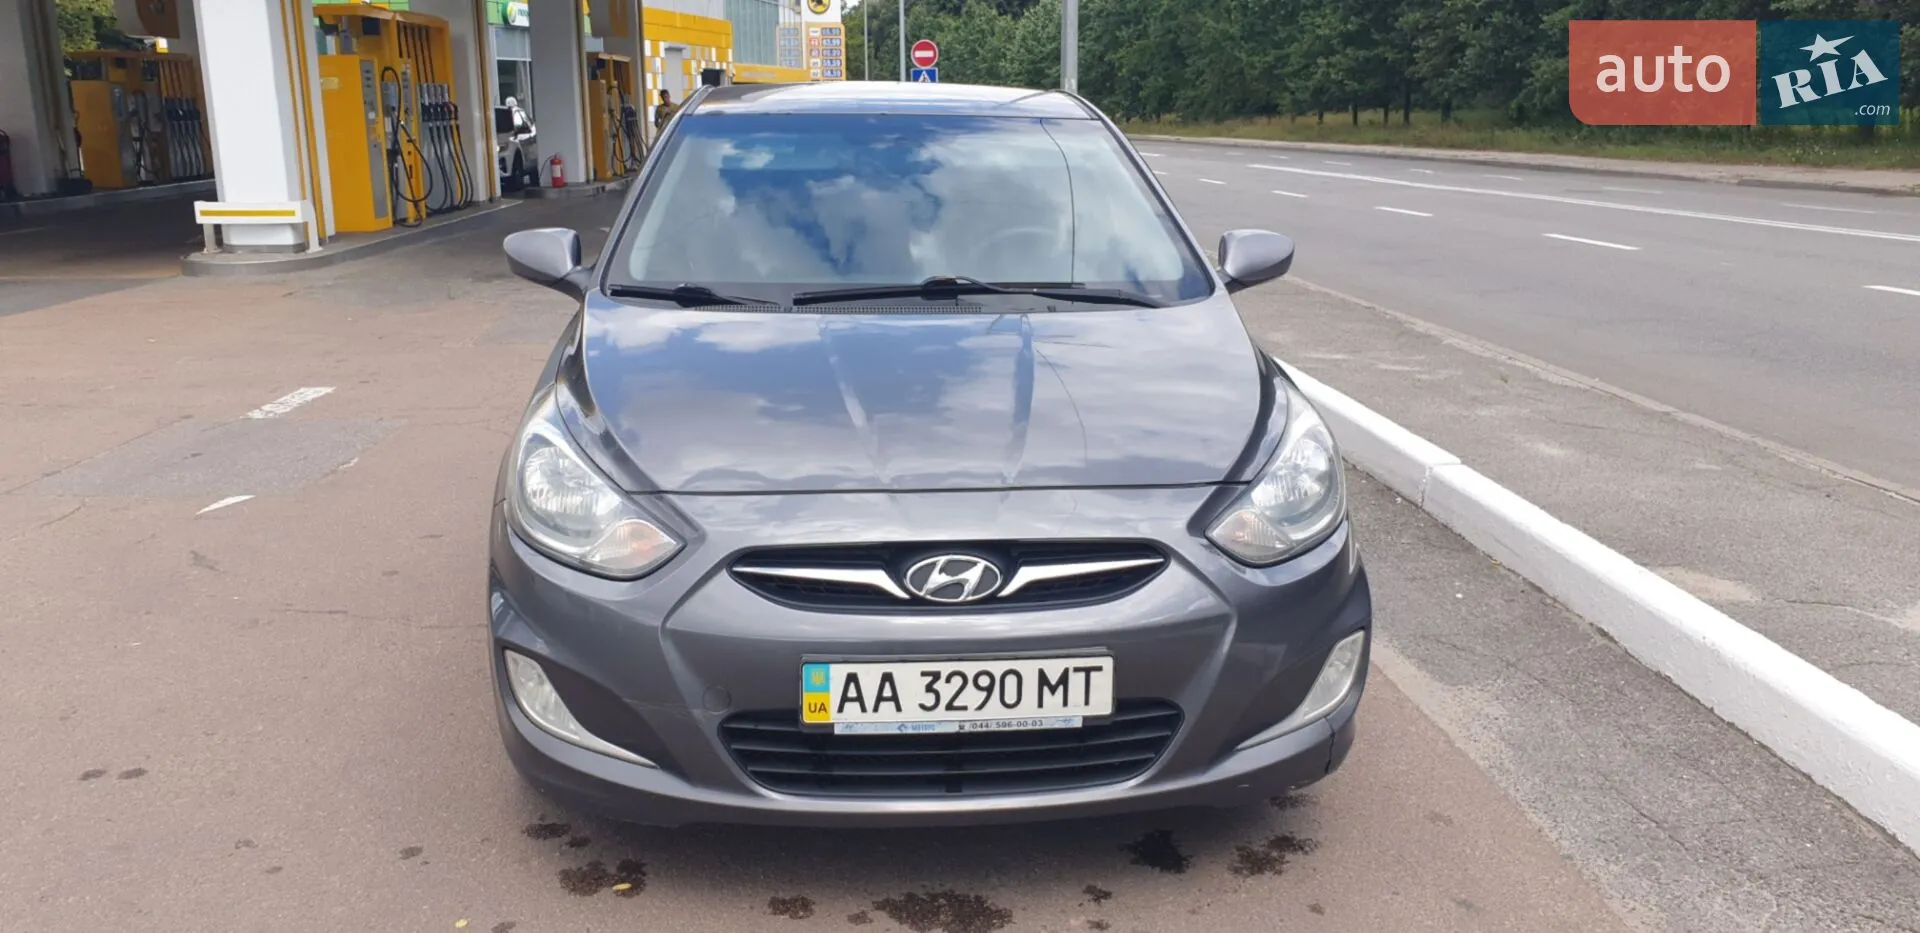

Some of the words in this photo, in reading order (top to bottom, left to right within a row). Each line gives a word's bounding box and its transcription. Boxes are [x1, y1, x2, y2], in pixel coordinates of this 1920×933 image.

[836, 671, 903, 714] AA
[917, 668, 1023, 713] 3290
[1036, 665, 1104, 709] MT
[807, 701, 828, 714] UA
